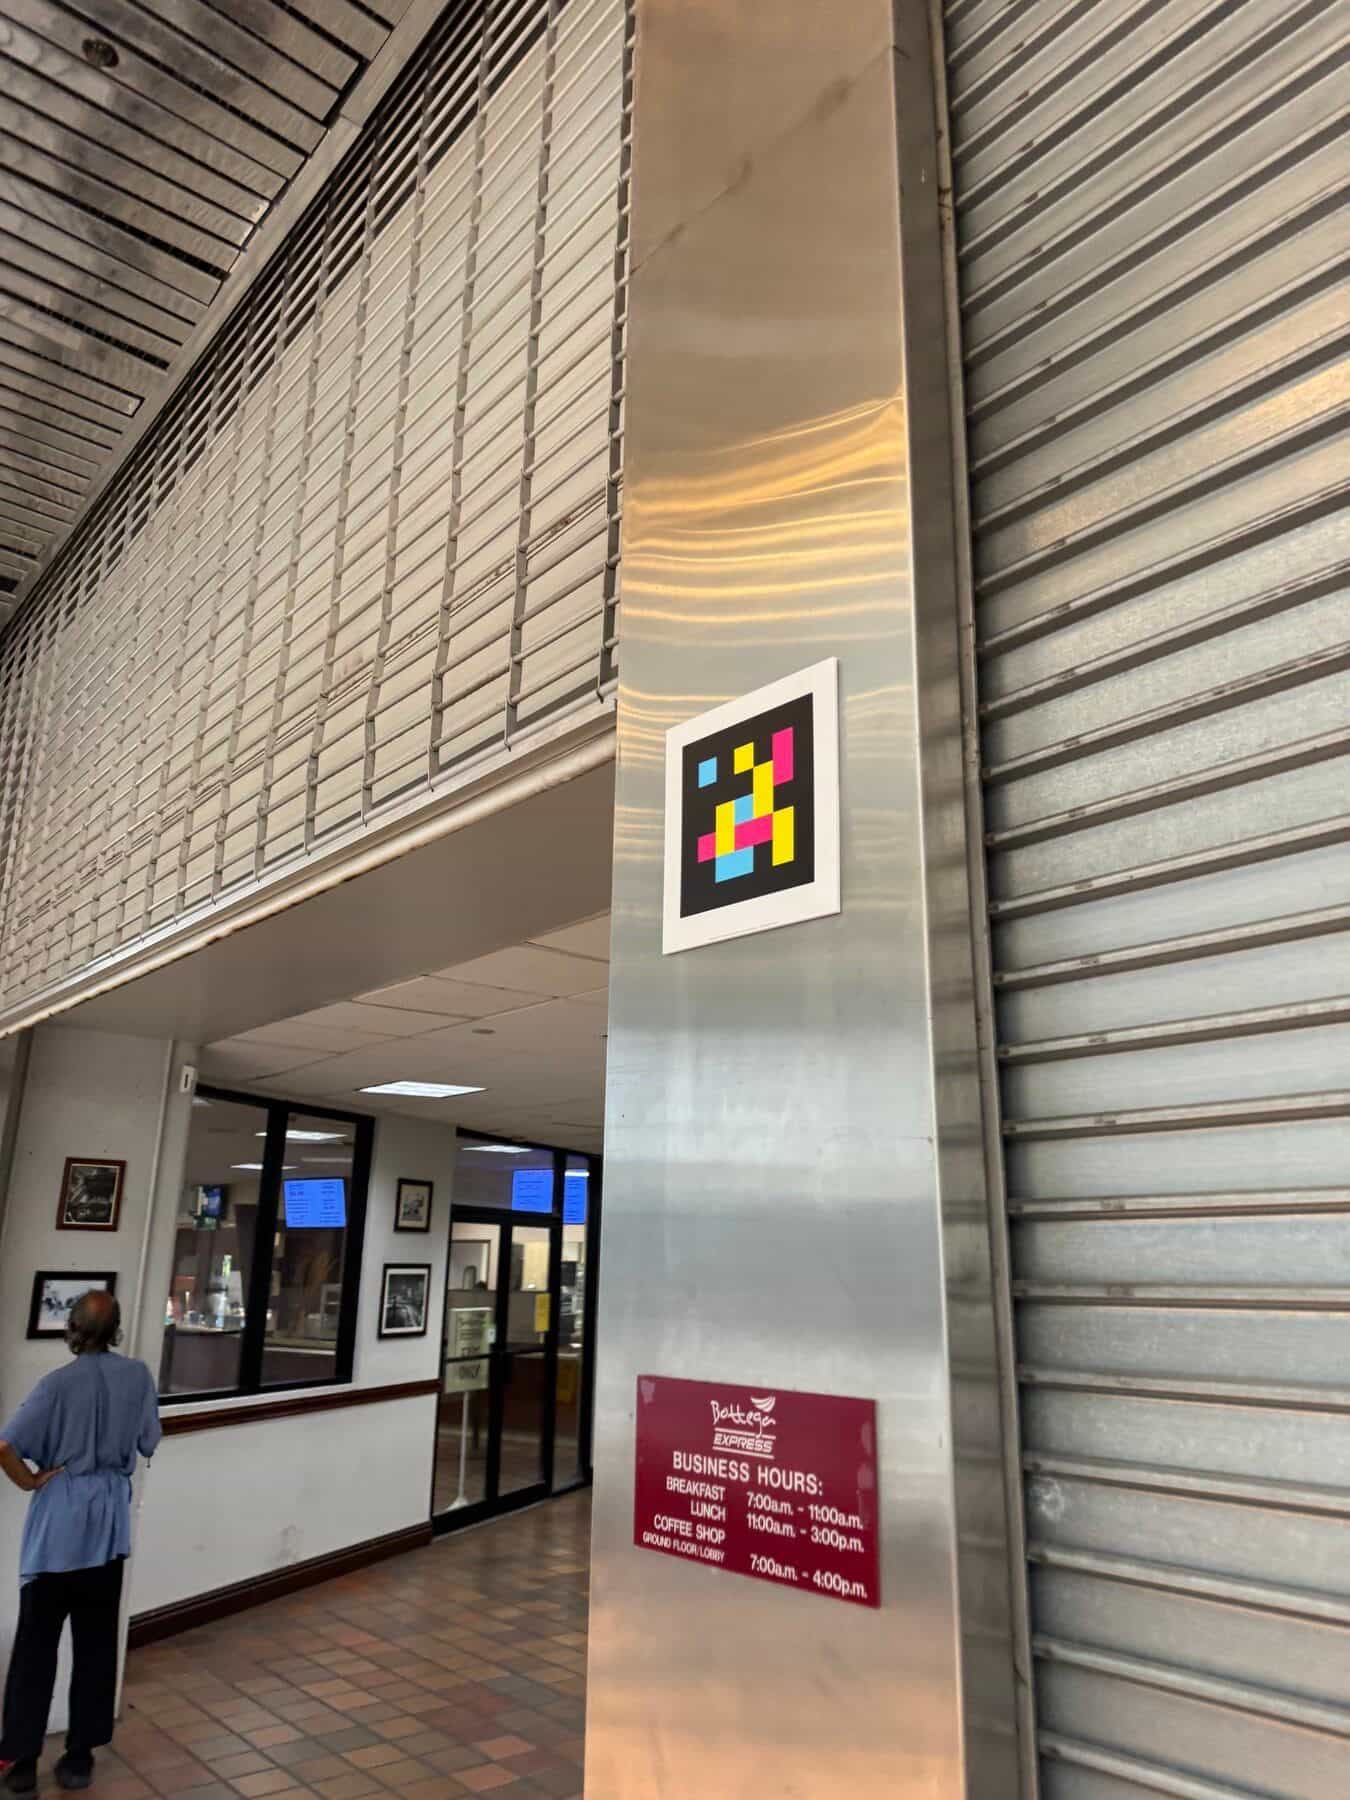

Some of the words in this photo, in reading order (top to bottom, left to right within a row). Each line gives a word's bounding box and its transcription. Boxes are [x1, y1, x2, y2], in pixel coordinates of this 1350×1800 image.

[711, 1400, 776, 1439] Bottega
[714, 1433, 773, 1453] EXPRESS
[673, 1451, 750, 1482] BUSINESS
[757, 1465, 823, 1496] HOURS:
[666, 1476, 726, 1501] BREAKFAST
[746, 1491, 794, 1516] 7:00a.m.
[808, 1504, 864, 1530] 11:00a.m.
[653, 1513, 693, 1537] COFFEE
[695, 1523, 726, 1544] SHOP
[690, 1500, 727, 1523] LUNCH
[746, 1512, 796, 1538] 11:00a.m.
[810, 1525, 865, 1553] 3:00p.m.
[642, 1531, 672, 1549] GROUND
[750, 1553, 798, 1581] 7:00a.m.
[812, 1569, 868, 1599] 4:00p.m.
